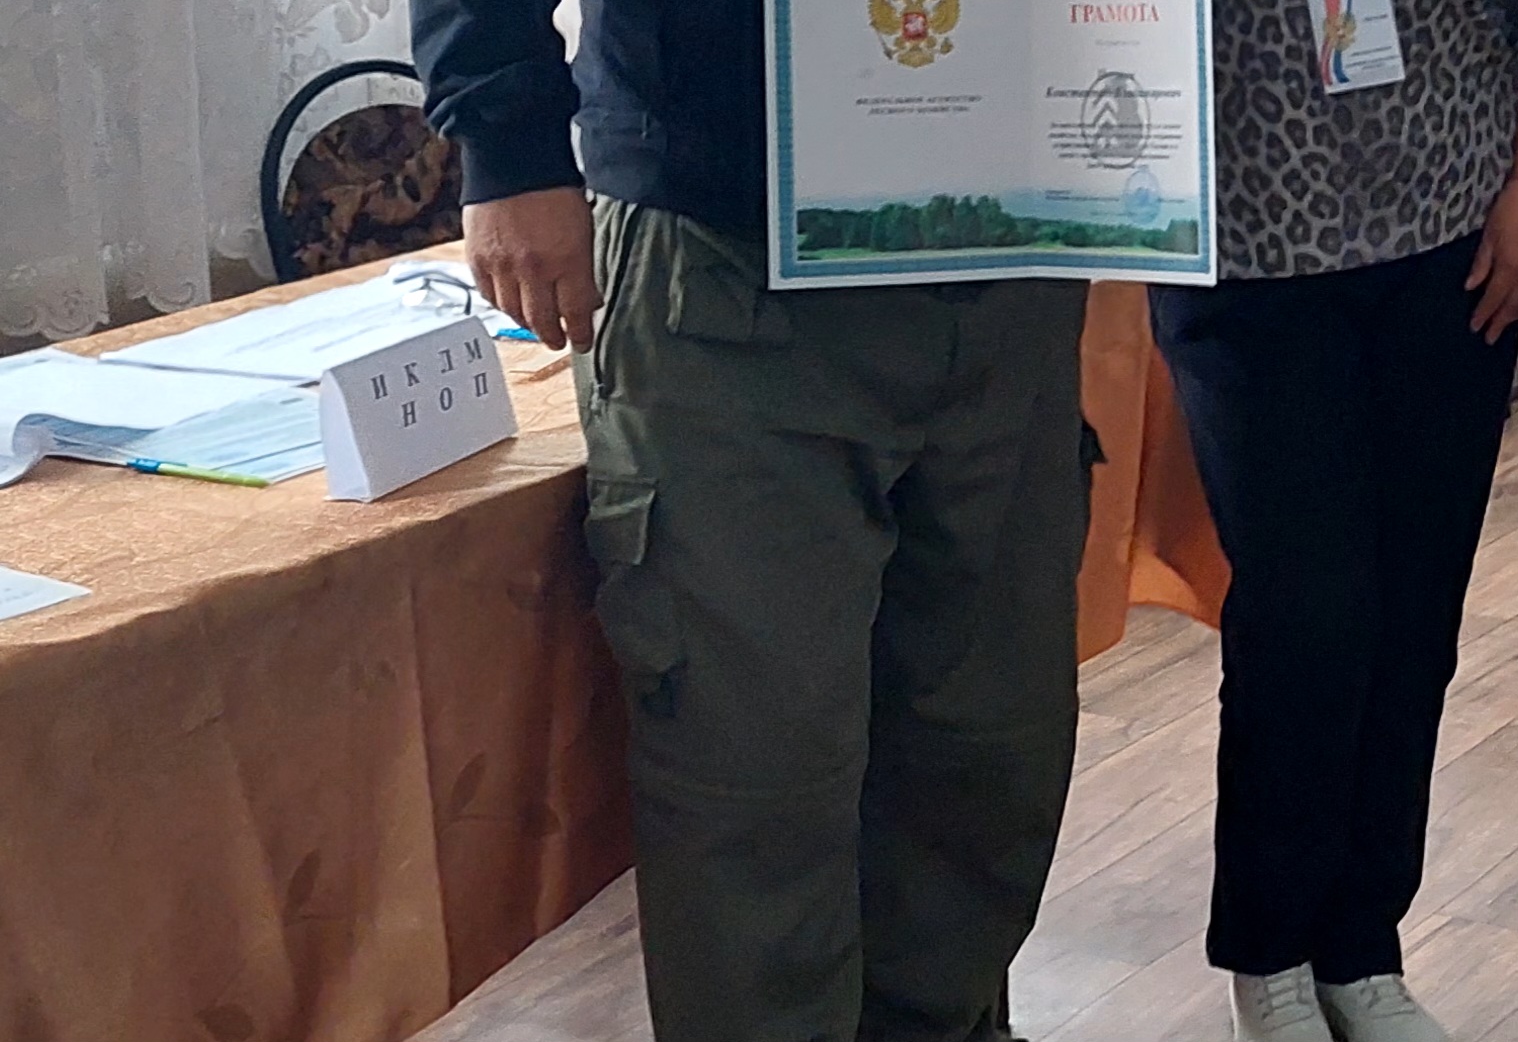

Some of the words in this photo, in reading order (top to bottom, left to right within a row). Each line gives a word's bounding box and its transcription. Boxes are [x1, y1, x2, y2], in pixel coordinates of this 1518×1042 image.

[1070, 3, 1159, 24] ГРАМОТА
[371, 374, 388, 400] И
[404, 362, 420, 387] К
[438, 349, 455, 374] Л
[464, 338, 483, 363] М
[401, 401, 417, 428] Н
[439, 387, 453, 411] О
[474, 372, 488, 398] П
